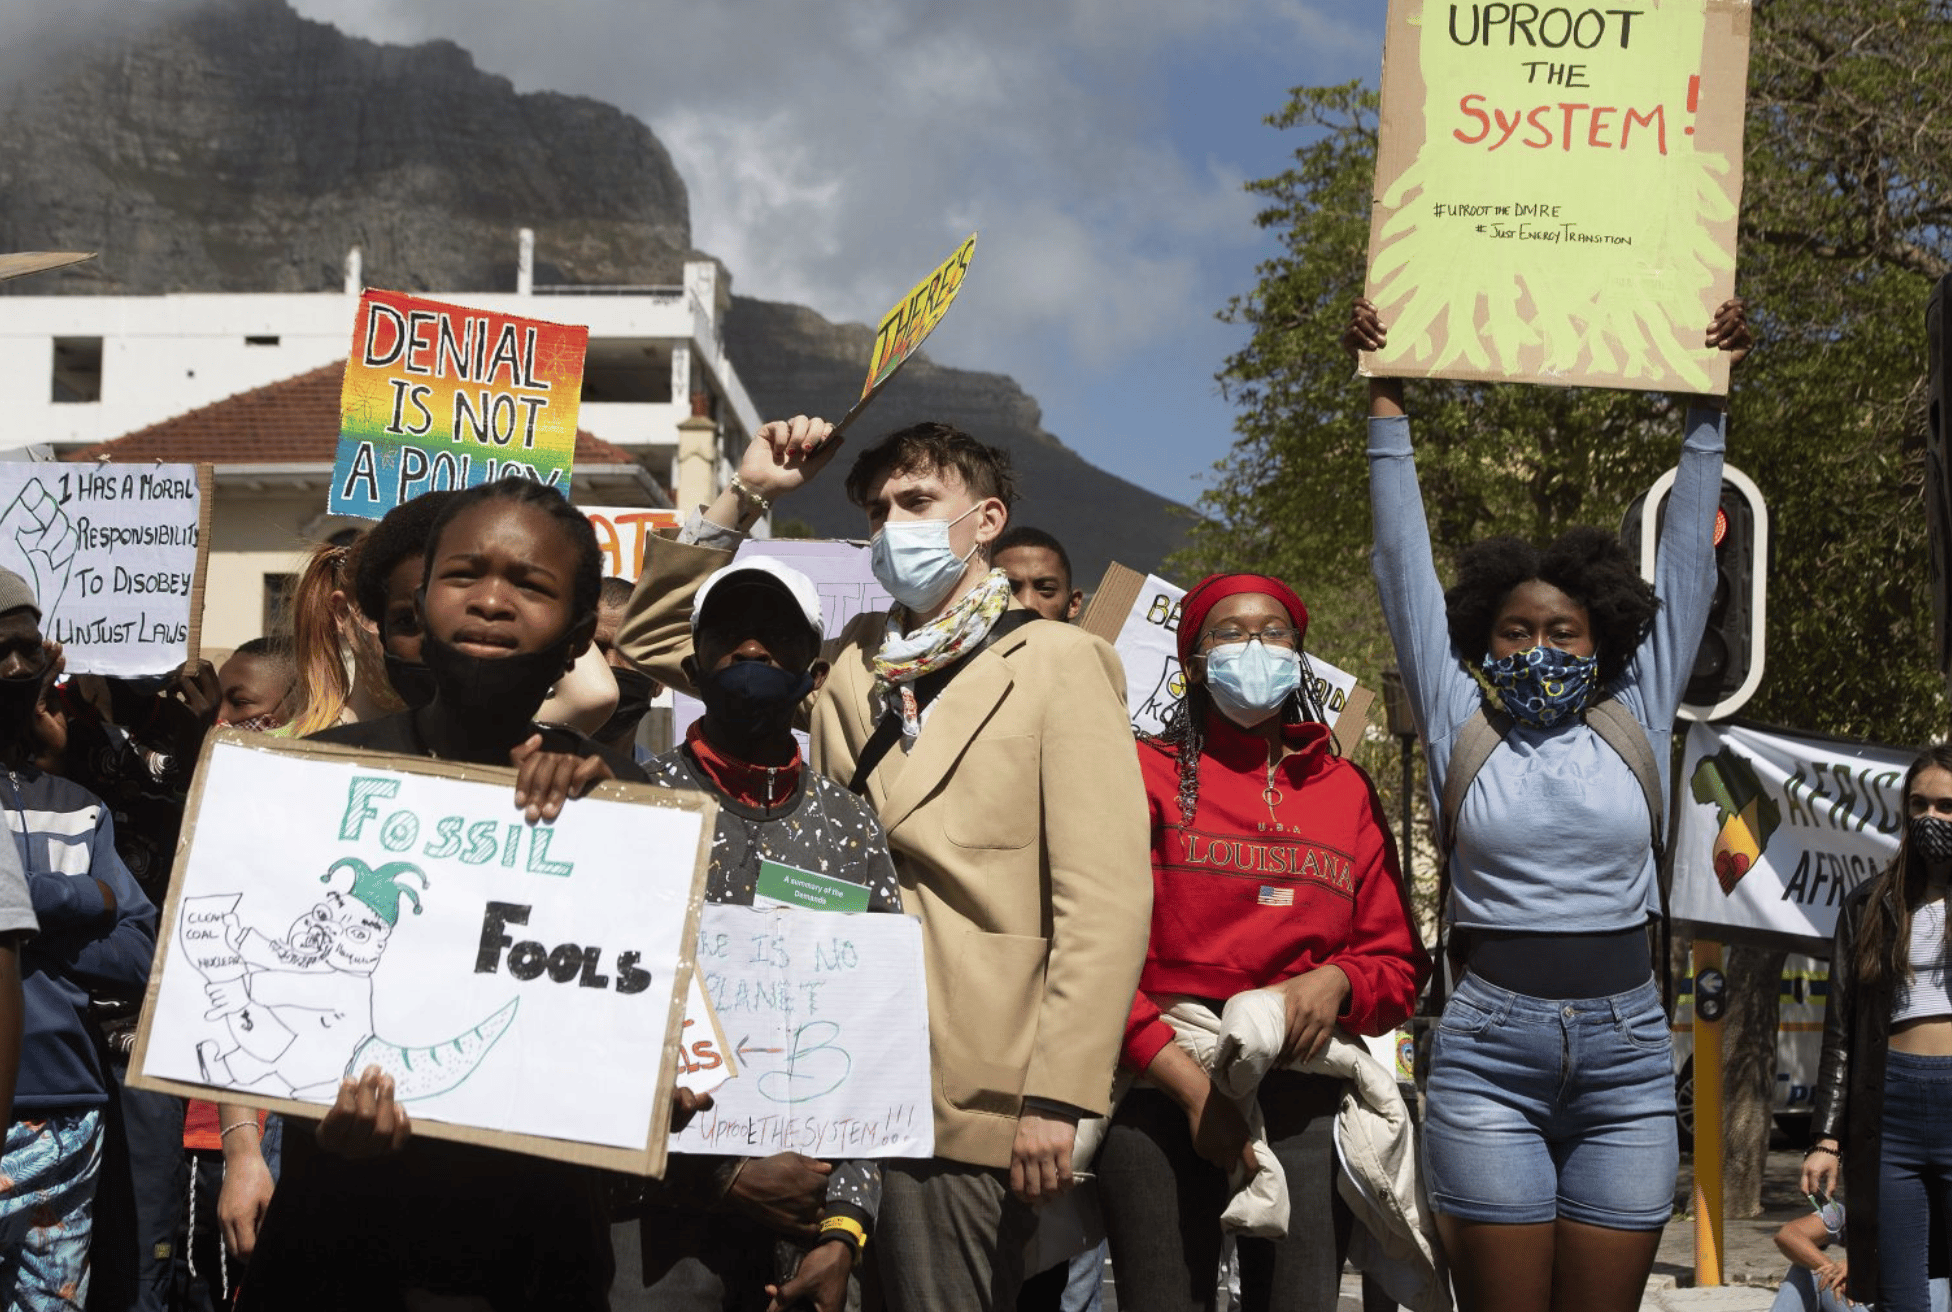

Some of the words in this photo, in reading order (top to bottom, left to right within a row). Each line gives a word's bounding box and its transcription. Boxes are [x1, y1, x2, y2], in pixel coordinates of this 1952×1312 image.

[1448, 2, 1645, 49] UPROOT
[1521, 61, 1591, 88] THE
[365, 303, 551, 389] DENIAL
[386, 380, 432, 435] IS
[452, 389, 548, 449] NOT
[78, 474, 117, 501] HAS
[121, 475, 133, 500] A
[140, 474, 194, 501] MORAL
[342, 443, 380, 502] A
[113, 566, 191, 596] DISOBEY
[56, 616, 137, 645] UNJUST
[138, 612, 188, 643] LAWS
[1784, 761, 1902, 834] AFRIC
[1185, 834, 1354, 893] LOUISIANA
[186, 928, 219, 940] COAL
[700, 931, 729, 958] RE
[749, 935, 790, 969] IS
